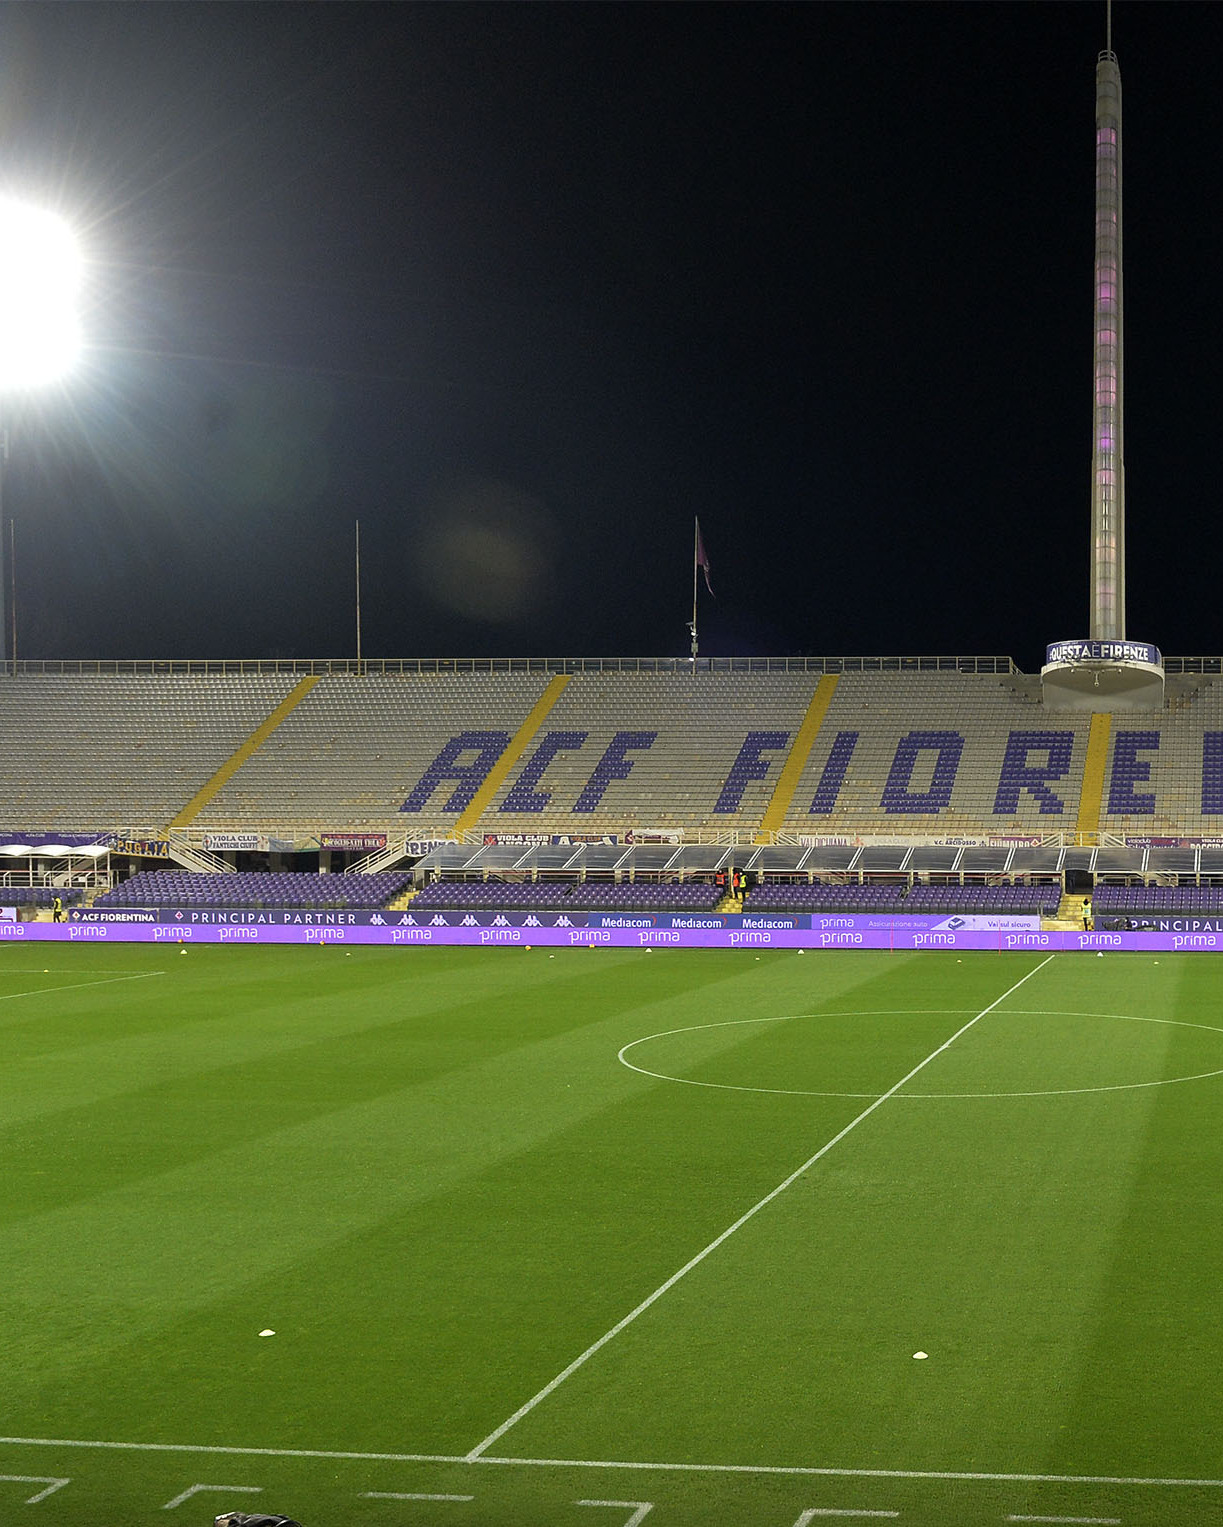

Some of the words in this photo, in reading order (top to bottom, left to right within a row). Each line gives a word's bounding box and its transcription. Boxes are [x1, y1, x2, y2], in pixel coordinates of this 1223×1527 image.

[398, 731, 658, 812] ACF
[100, 914, 155, 922] FIORENTINA
[191, 913, 275, 923] PRINCIPAL
[284, 914, 356, 924] PARTNER
[819, 918, 854, 930] prima
[68, 926, 107, 939] prima
[152, 926, 192, 940] prima
[217, 927, 258, 940] prima
[304, 928, 345, 941] prima
[391, 929, 432, 942] prima
[479, 930, 521, 943] prima
[568, 930, 611, 944] prima
[637, 931, 680, 944] prima
[728, 932, 771, 945] prima
[819, 932, 863, 946] prima
[912, 933, 956, 947] prima
[1005, 934, 1049, 947] prima
[1078, 934, 1122, 948] prima
[1172, 934, 1216, 948] prima
